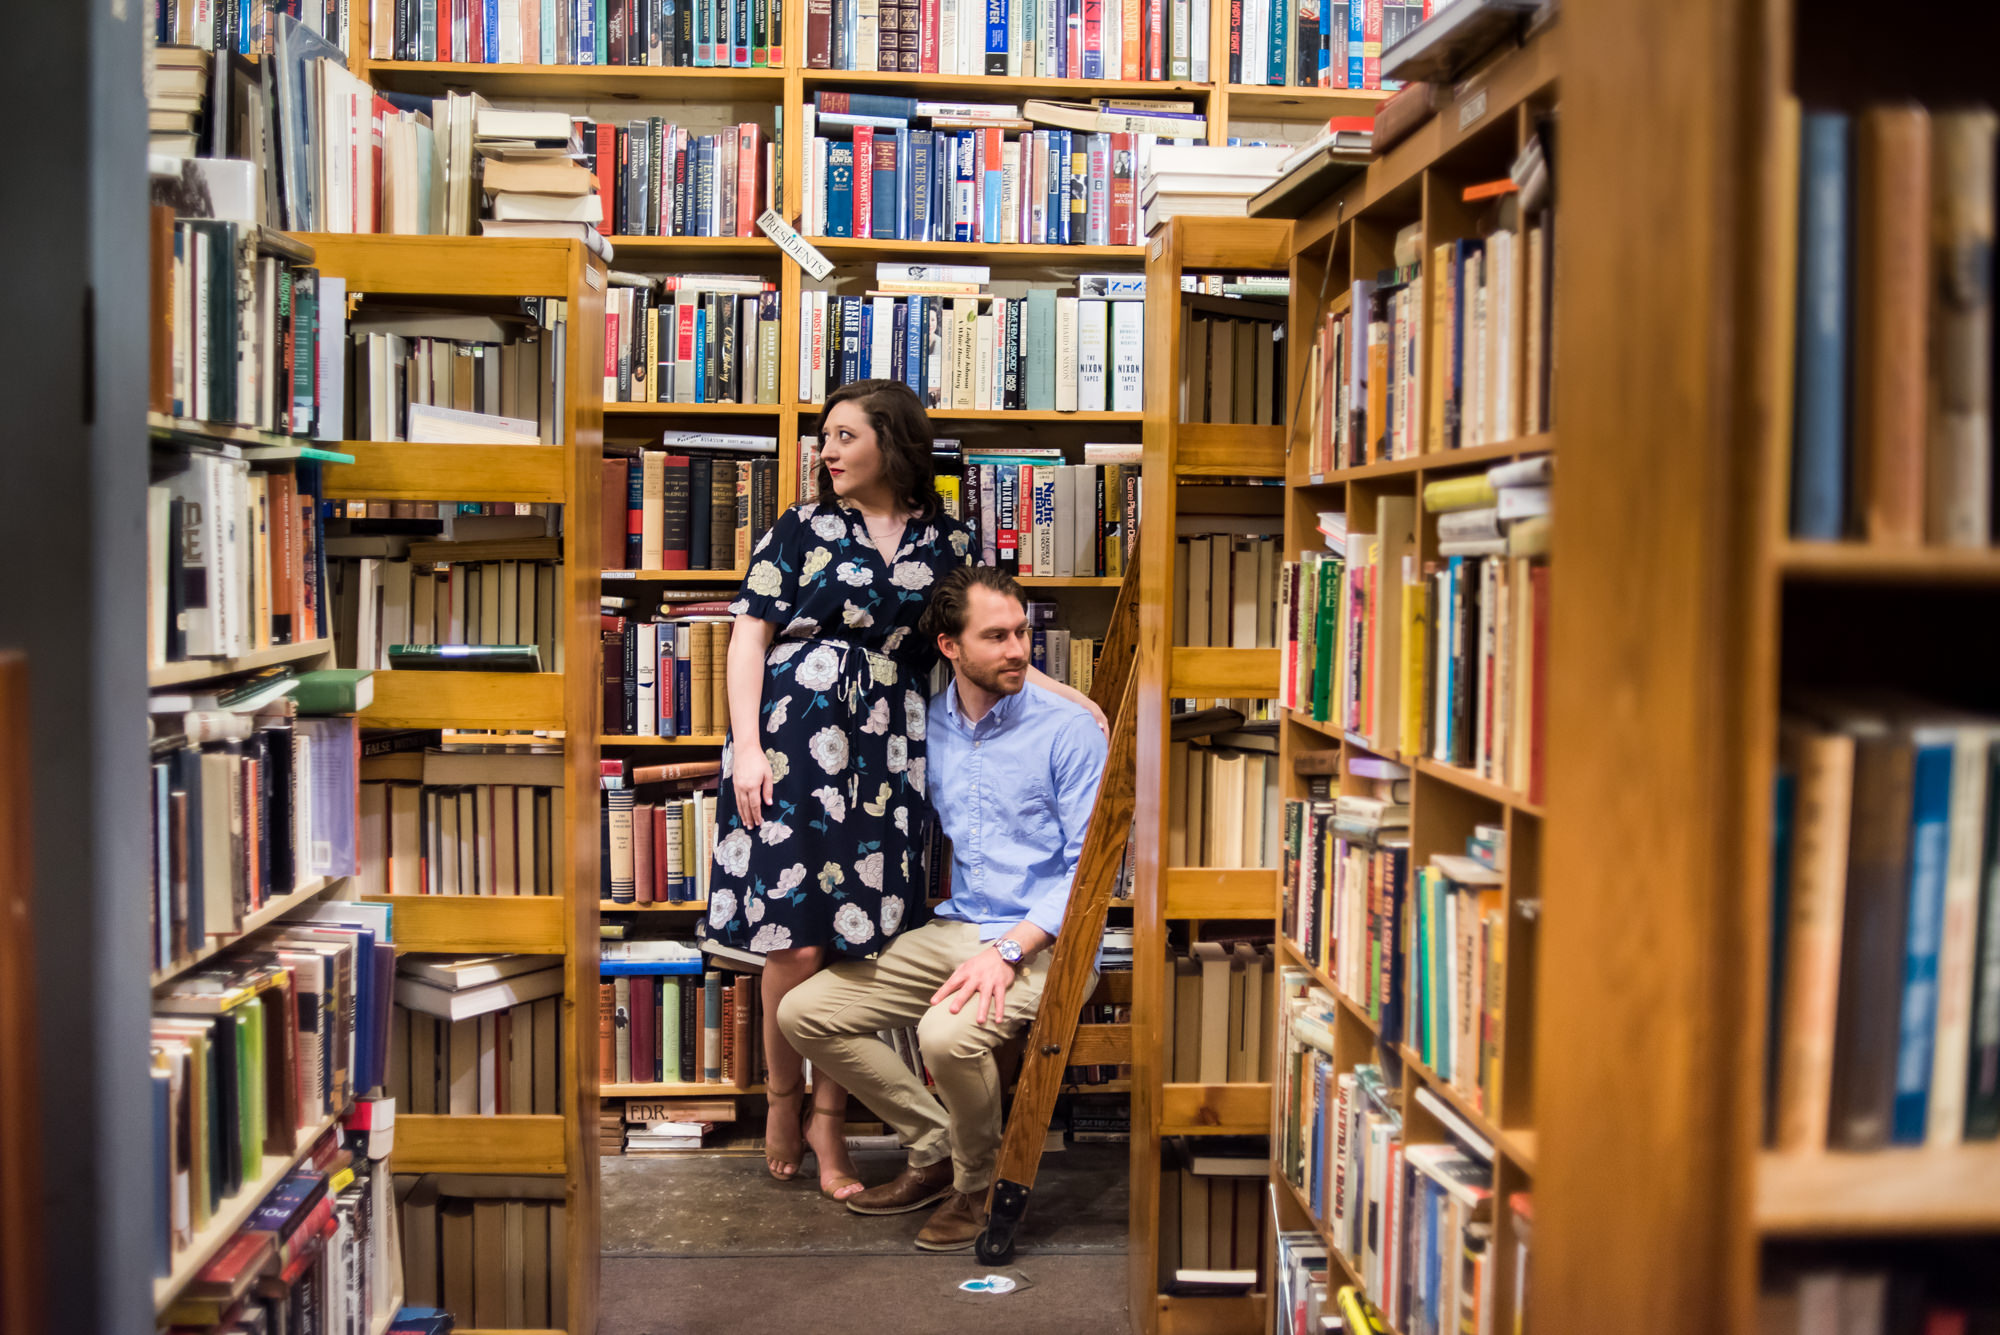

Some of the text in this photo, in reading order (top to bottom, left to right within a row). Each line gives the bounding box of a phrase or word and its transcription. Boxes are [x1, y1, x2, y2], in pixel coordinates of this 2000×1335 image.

[1152, 14, 1160, 33] BLUFF
[1231, 1, 1240, 26] HABITS
[925, 39, 934, 58] Years
[1274, 49, 1284, 63] WAR
[703, 165, 712, 210] EMPIRE
[915, 149, 926, 220] IKE THE SOLDIER
[1092, 151, 1103, 229] GUNS BUTTER
[676, 184, 684, 225] GREAT GAMBLE
[762, 212, 826, 274] PRESIDENTS
[280, 272, 290, 316] KINDNESS
[910, 304, 919, 325] CHIEF
[813, 308, 821, 370] FROST ON NIXON
[910, 336, 919, 358] STAFF
[720, 350, 733, 382] Hickory
[955, 370, 963, 389] Diary
[1081, 364, 1102, 373] NIXON
[1118, 365, 1139, 373] NIXON
[967, 467, 977, 486] CRAZY
[1002, 481, 1012, 529] NIXONLAND
[1036, 487, 1044, 525] mare
[1042, 482, 1054, 527] Night-
[631, 1105, 669, 1120] F.D.R.
